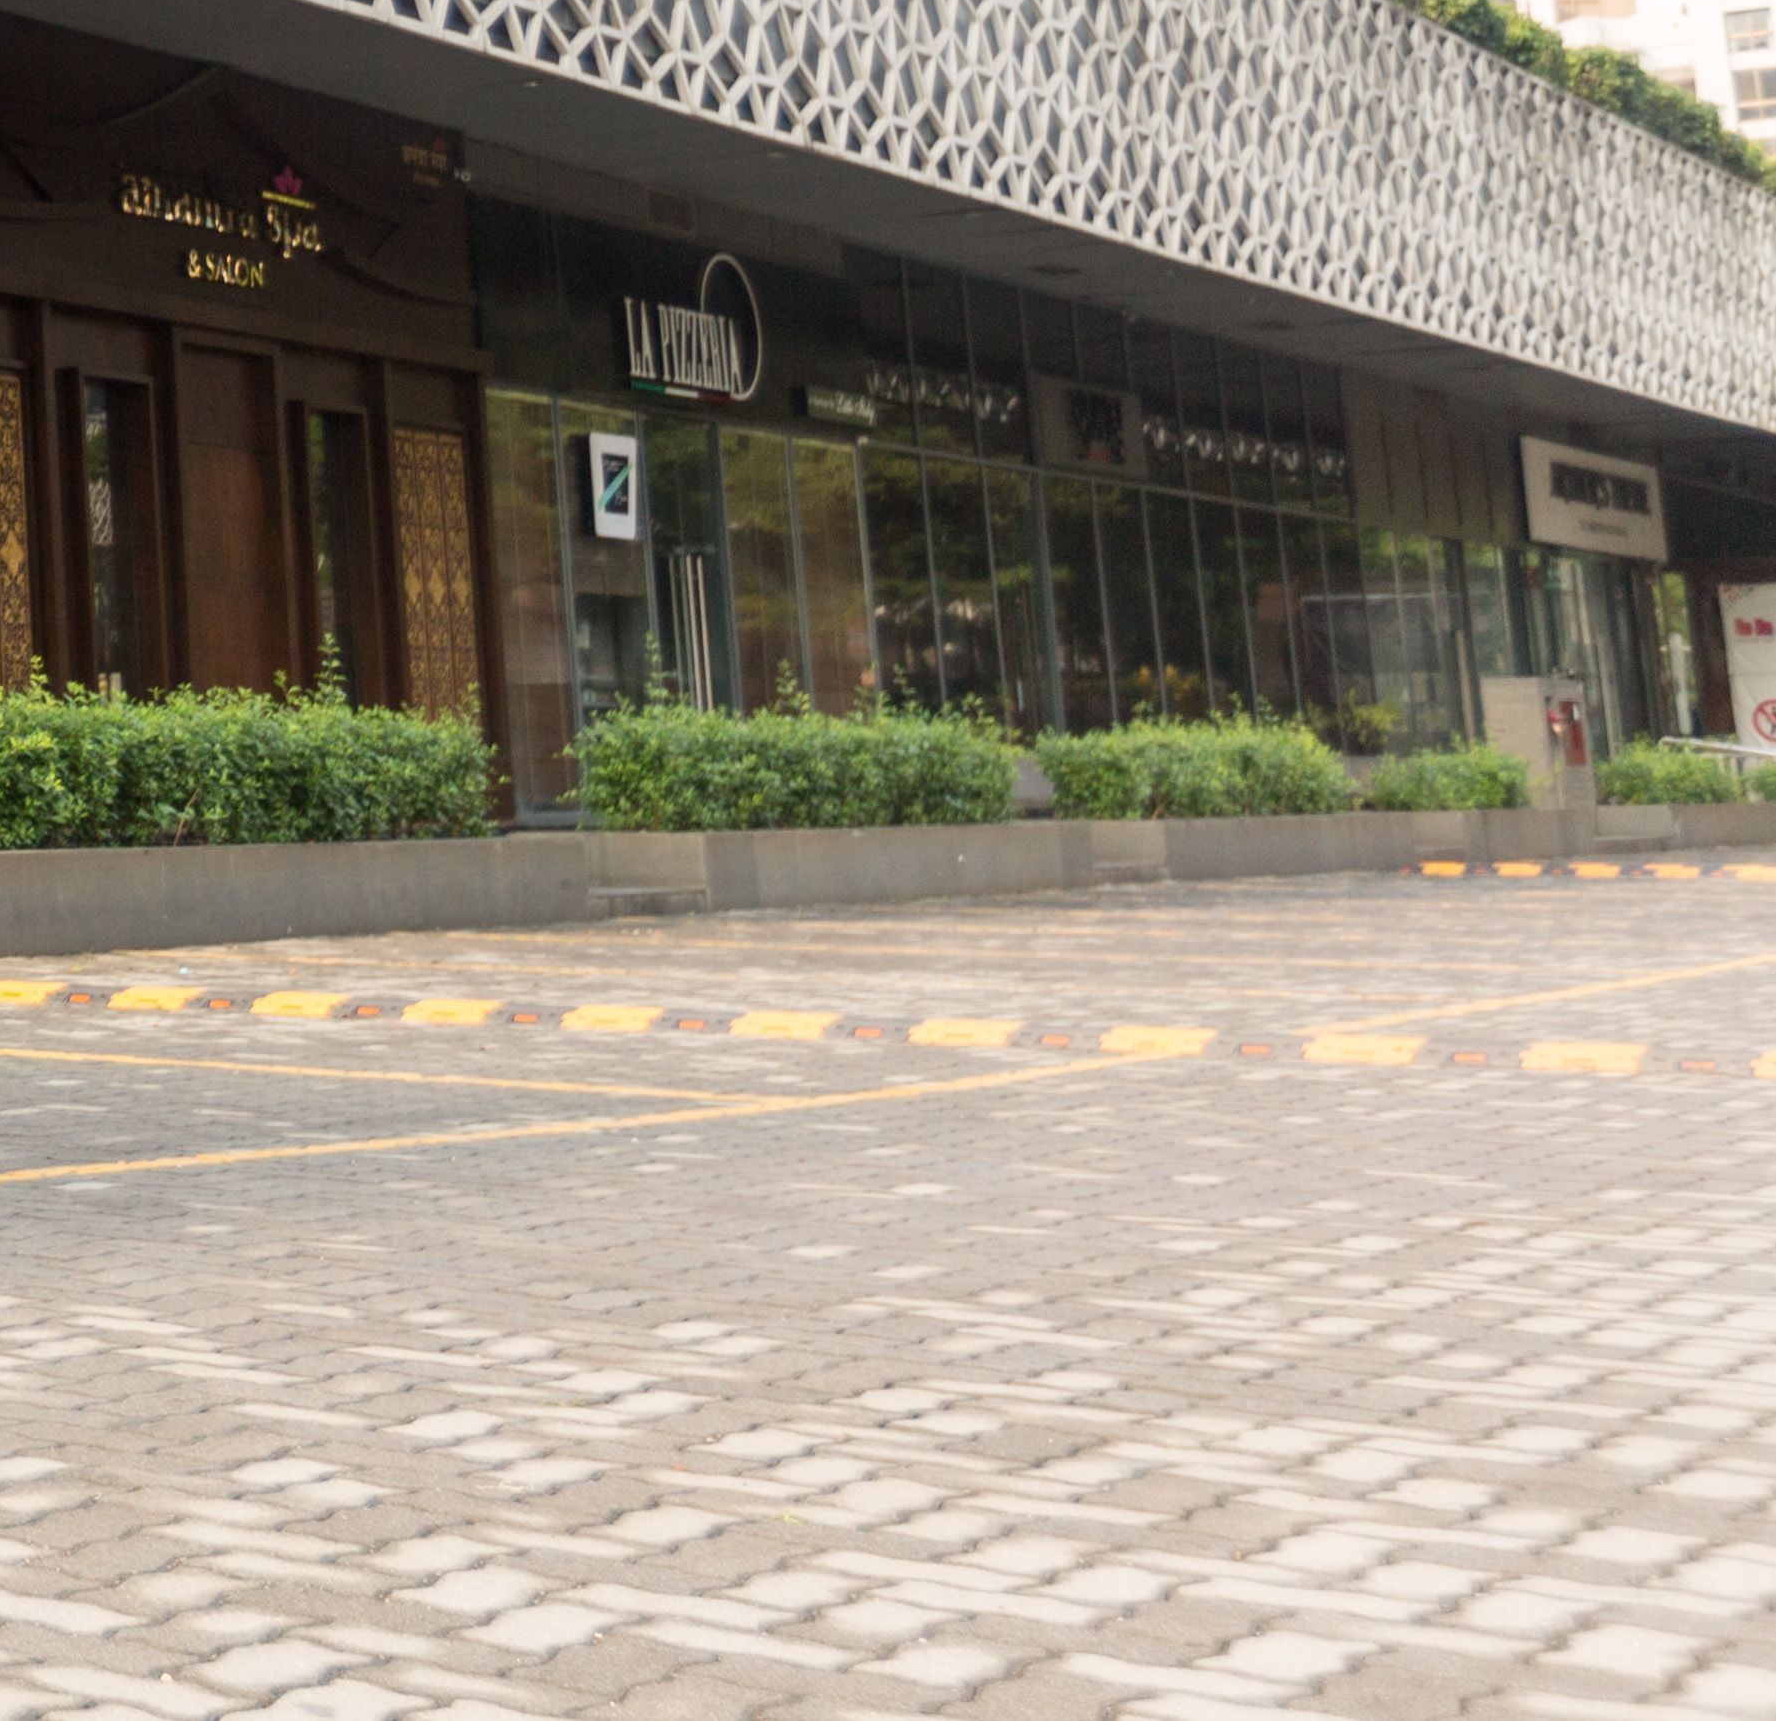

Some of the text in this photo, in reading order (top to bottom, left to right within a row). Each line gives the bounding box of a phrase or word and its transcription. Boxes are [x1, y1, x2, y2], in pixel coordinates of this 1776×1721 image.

[205, 253, 265, 288] SALON
[624, 296, 744, 396] LA PIZZERIA
